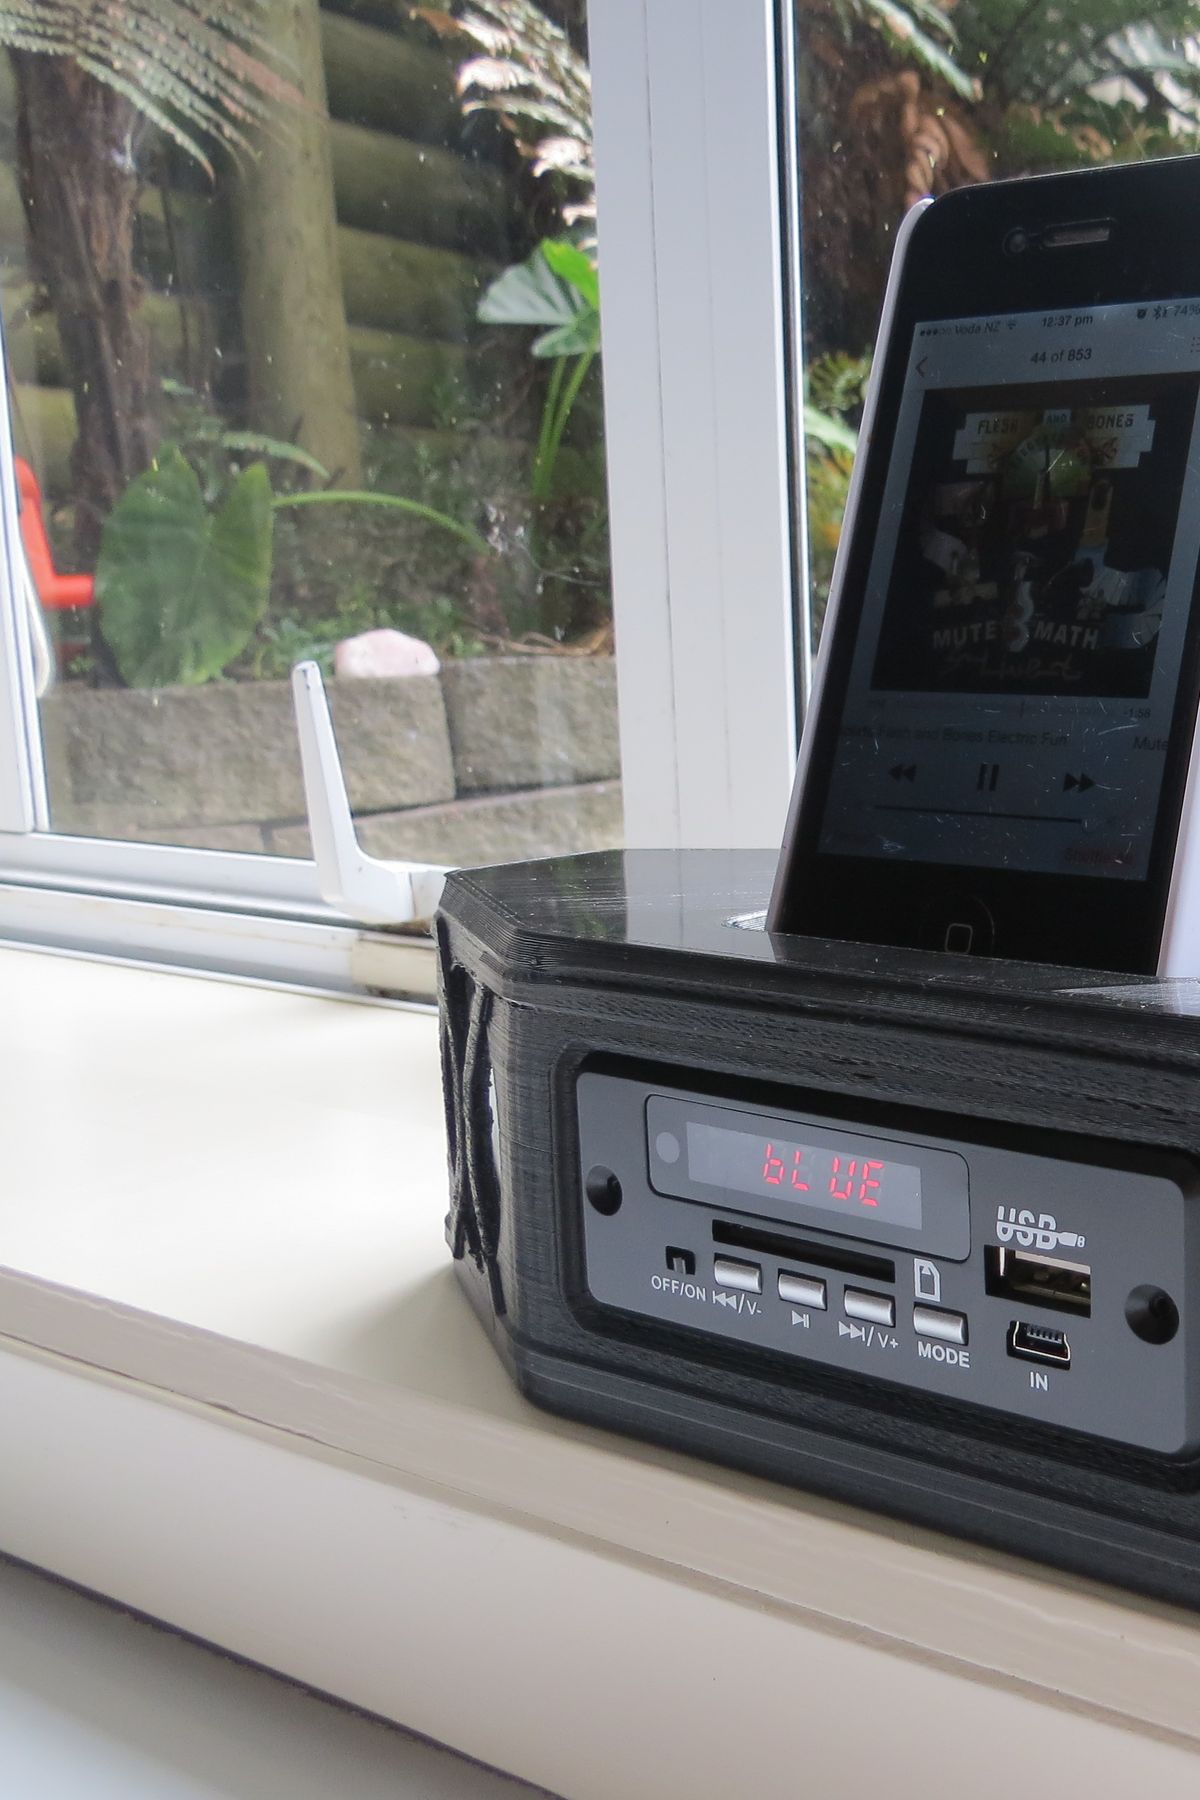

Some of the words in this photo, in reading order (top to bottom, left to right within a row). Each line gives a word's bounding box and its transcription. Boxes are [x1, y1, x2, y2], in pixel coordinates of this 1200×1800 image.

[1042, 317, 1072, 328] 12:37
[1074, 315, 1093, 327] pm
[1030, 351, 1046, 364] 44
[1050, 350, 1064, 363] of
[1068, 348, 1092, 361] 853
[933, 620, 997, 648] MUTE
[1034, 620, 1100, 650] MATH
[996, 1205, 1058, 1250] USB
[651, 1275, 706, 1302] OFF/ON
[917, 1340, 971, 1369] MODE
[1029, 1371, 1049, 1392] IN
